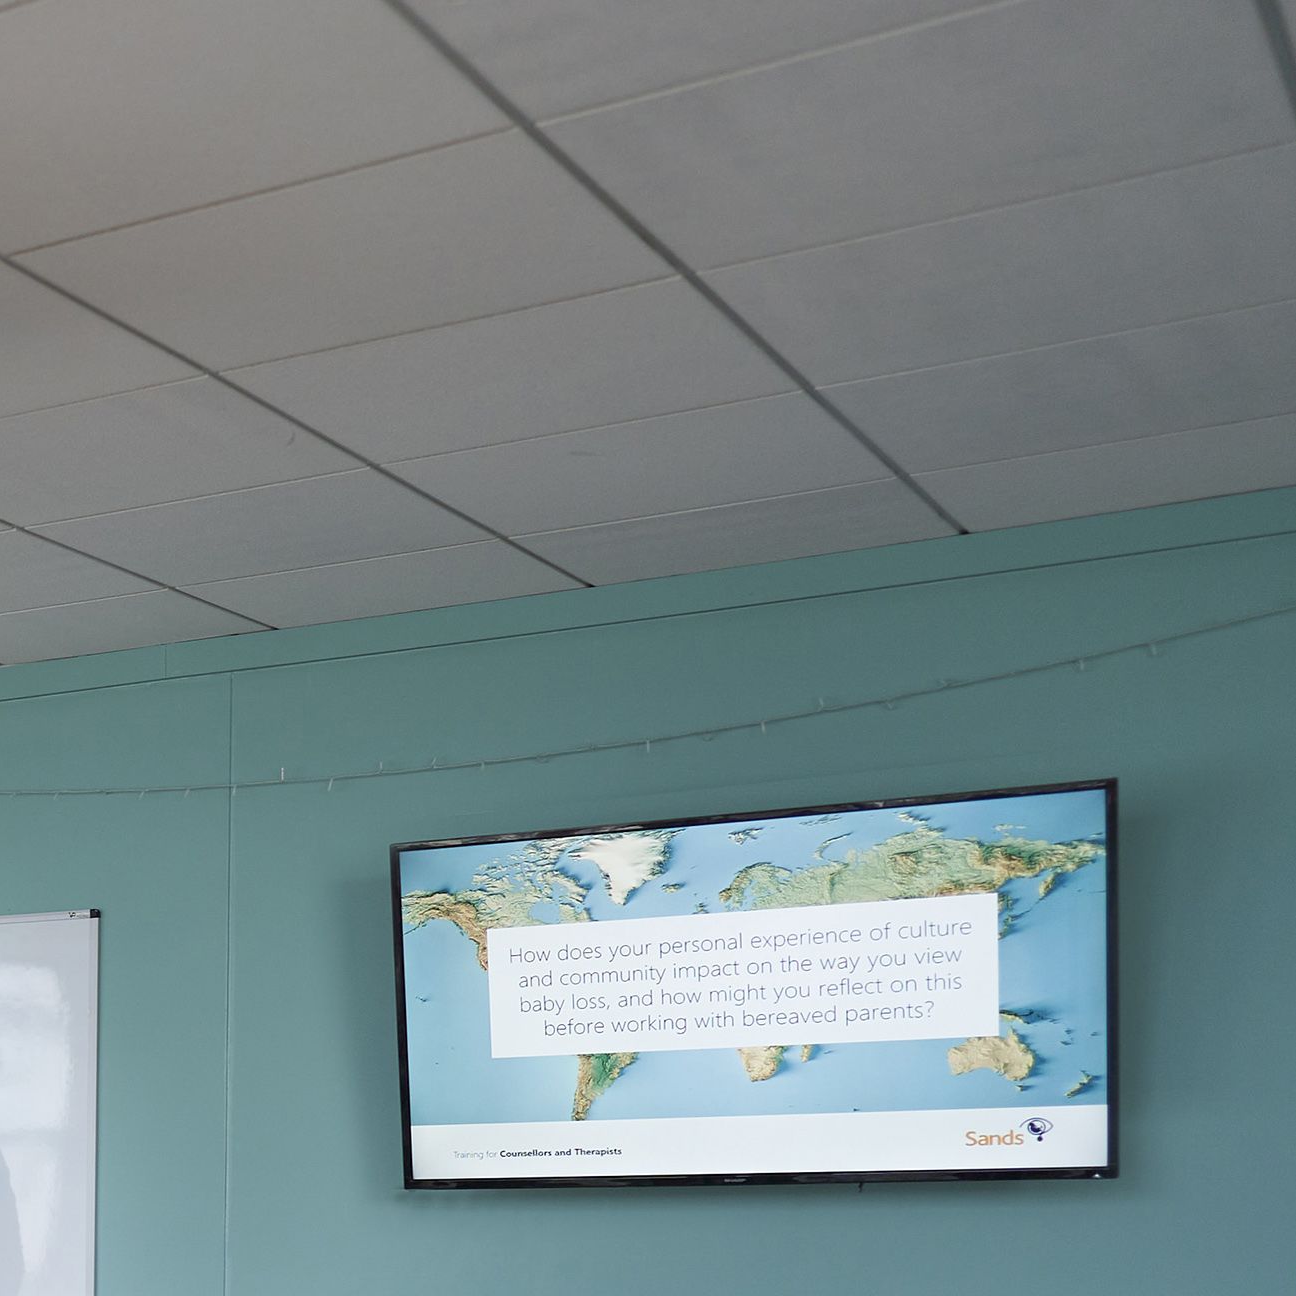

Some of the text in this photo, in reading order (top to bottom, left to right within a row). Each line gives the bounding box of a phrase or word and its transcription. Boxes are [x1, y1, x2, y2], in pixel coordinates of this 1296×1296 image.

[509, 920, 973, 964] How does your personal experience of culture
[518, 947, 963, 988] and community impact on the way you view
[519, 973, 963, 1015] baby loss, and how might you reflect on this
[544, 1000, 935, 1036] before working with bereaved parents?
[453, 1146, 623, 1160] Training for Counsellors and Therapists
[965, 1129, 1024, 1147] Sands
